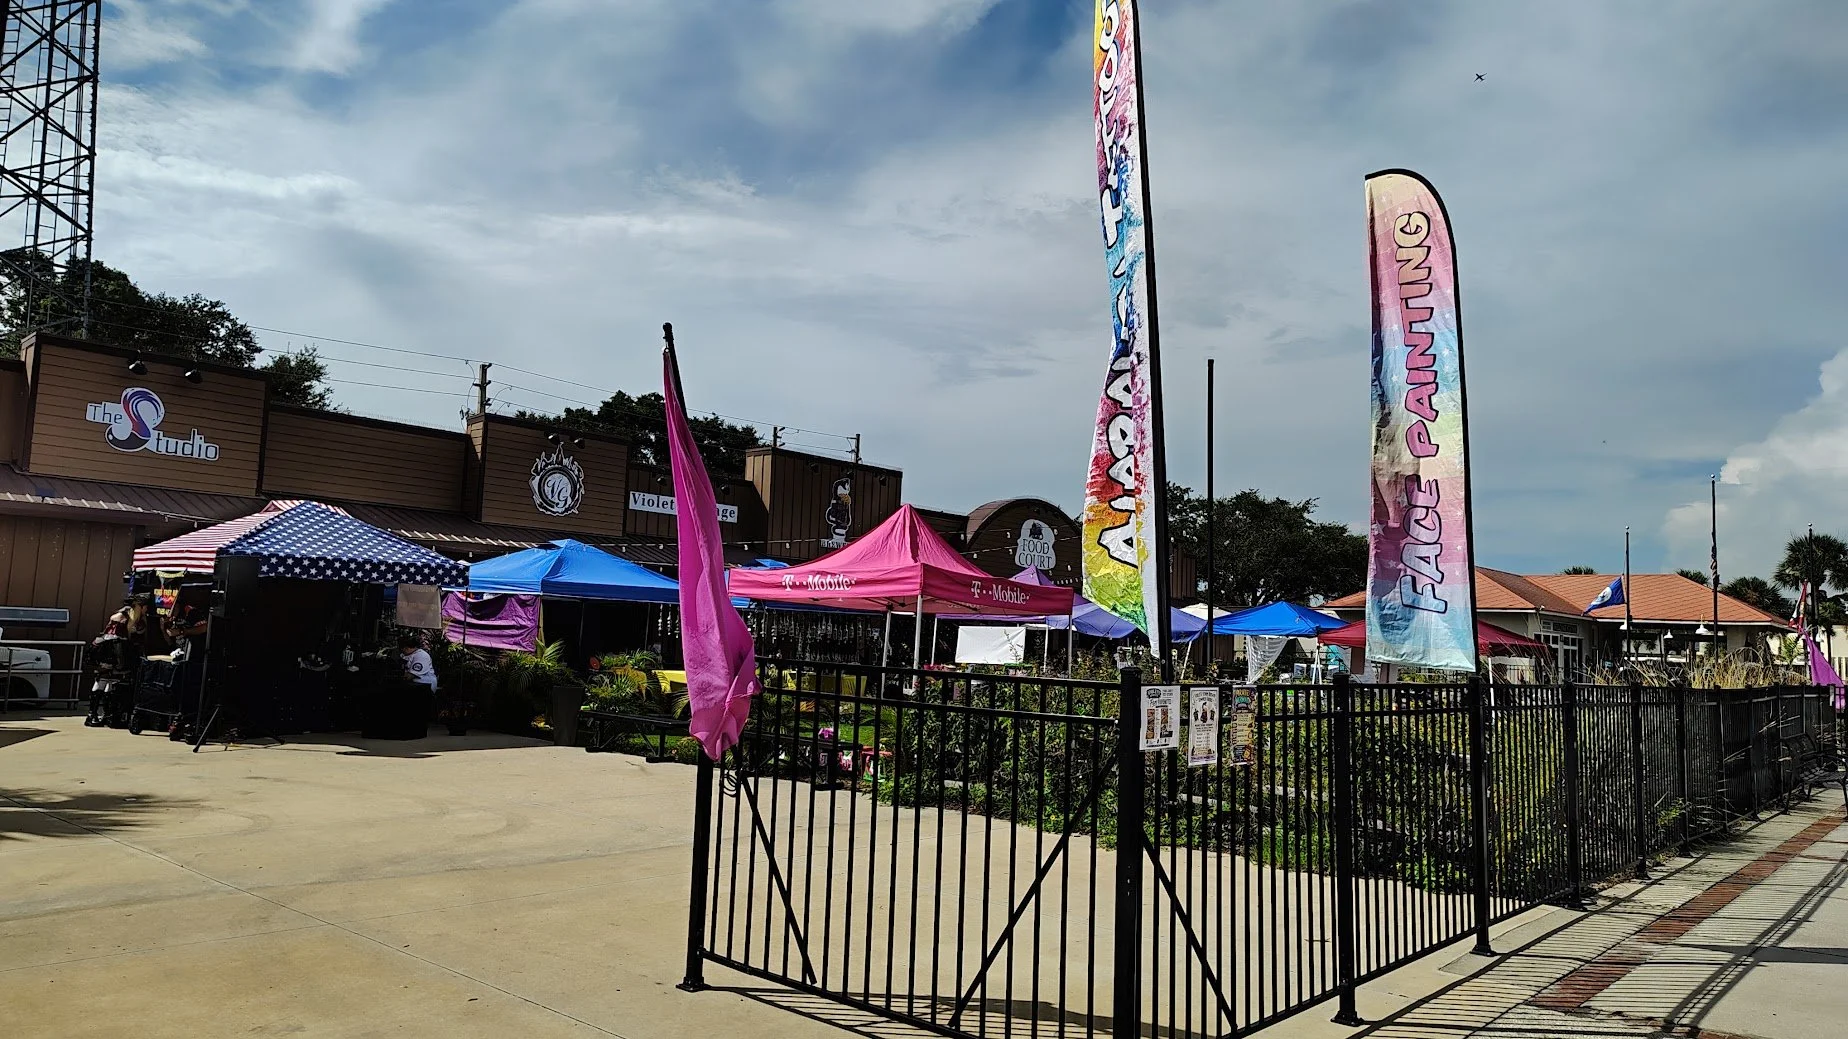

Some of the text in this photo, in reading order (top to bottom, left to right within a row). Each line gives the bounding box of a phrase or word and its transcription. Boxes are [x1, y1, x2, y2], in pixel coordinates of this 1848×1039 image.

[89, 387, 219, 461] The Studio
[1393, 211, 1448, 614] FACE PAINTING
[631, 492, 675, 511] Violet
[1018, 538, 1052, 568] FOOD COURT
